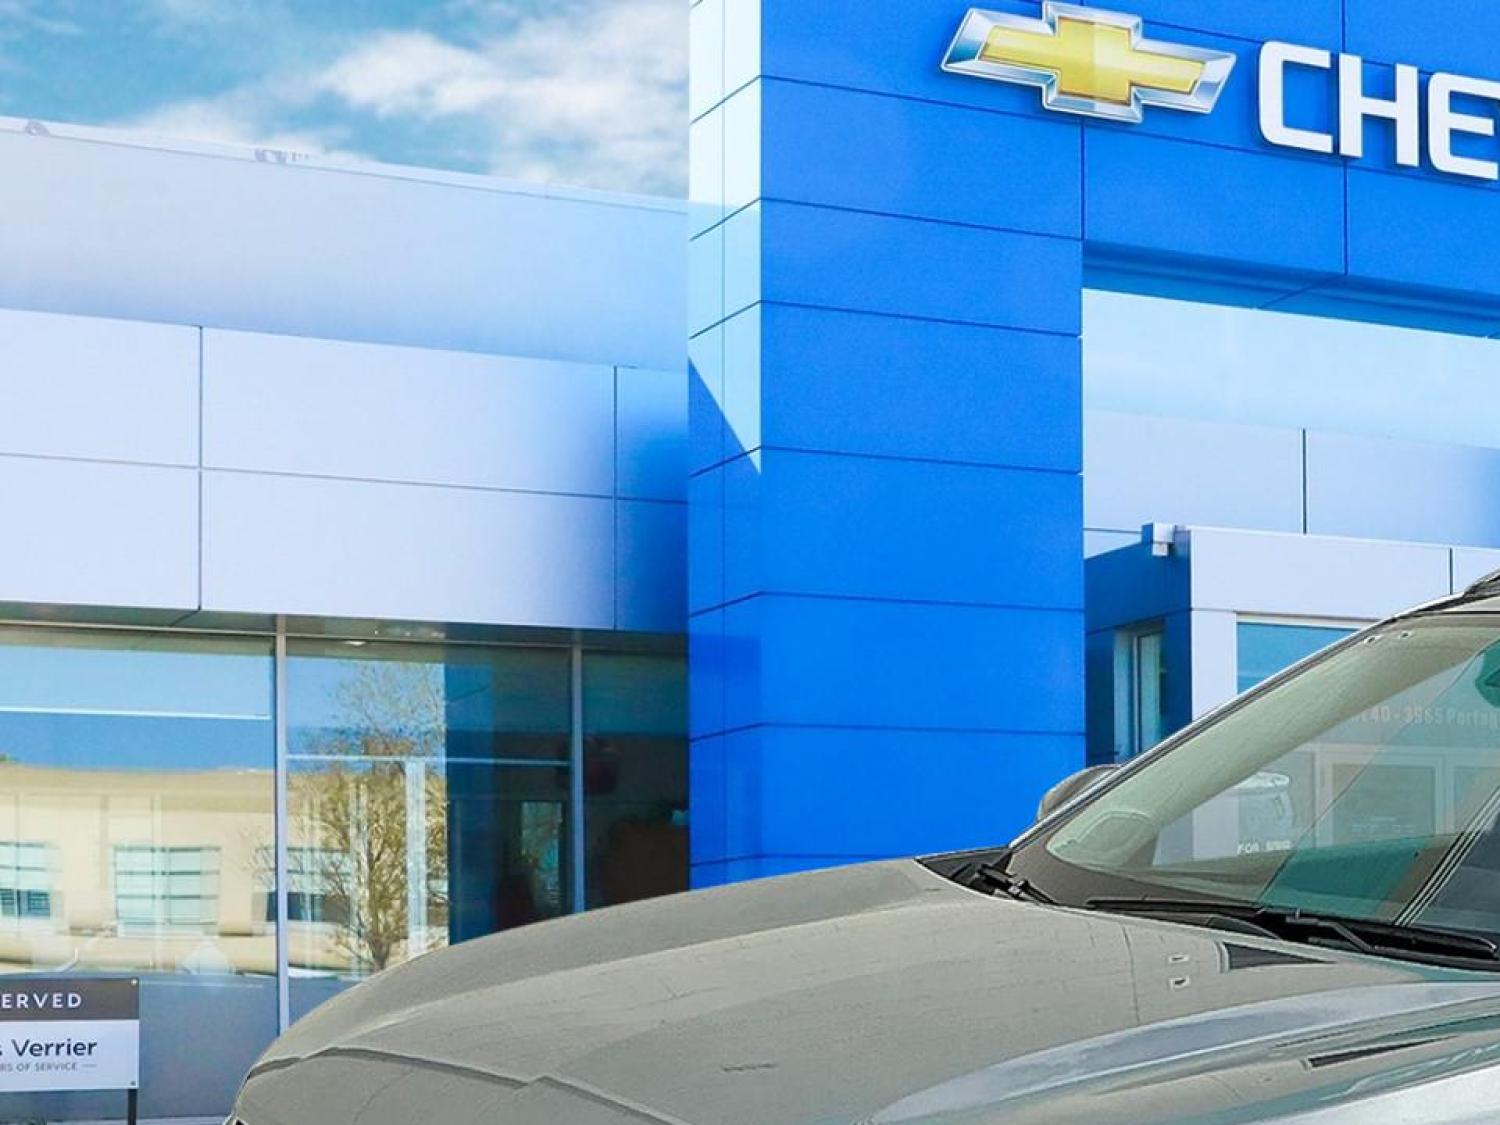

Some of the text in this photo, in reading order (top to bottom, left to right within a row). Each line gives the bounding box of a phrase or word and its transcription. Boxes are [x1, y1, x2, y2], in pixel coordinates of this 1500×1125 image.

[1403, 705, 1443, 727] 3965
[1, 993, 82, 1008] ERVED
[11, 1038, 98, 1056] Verrier
[16, 1063, 30, 1072] OF
[35, 1062, 78, 1072] SERVICE
